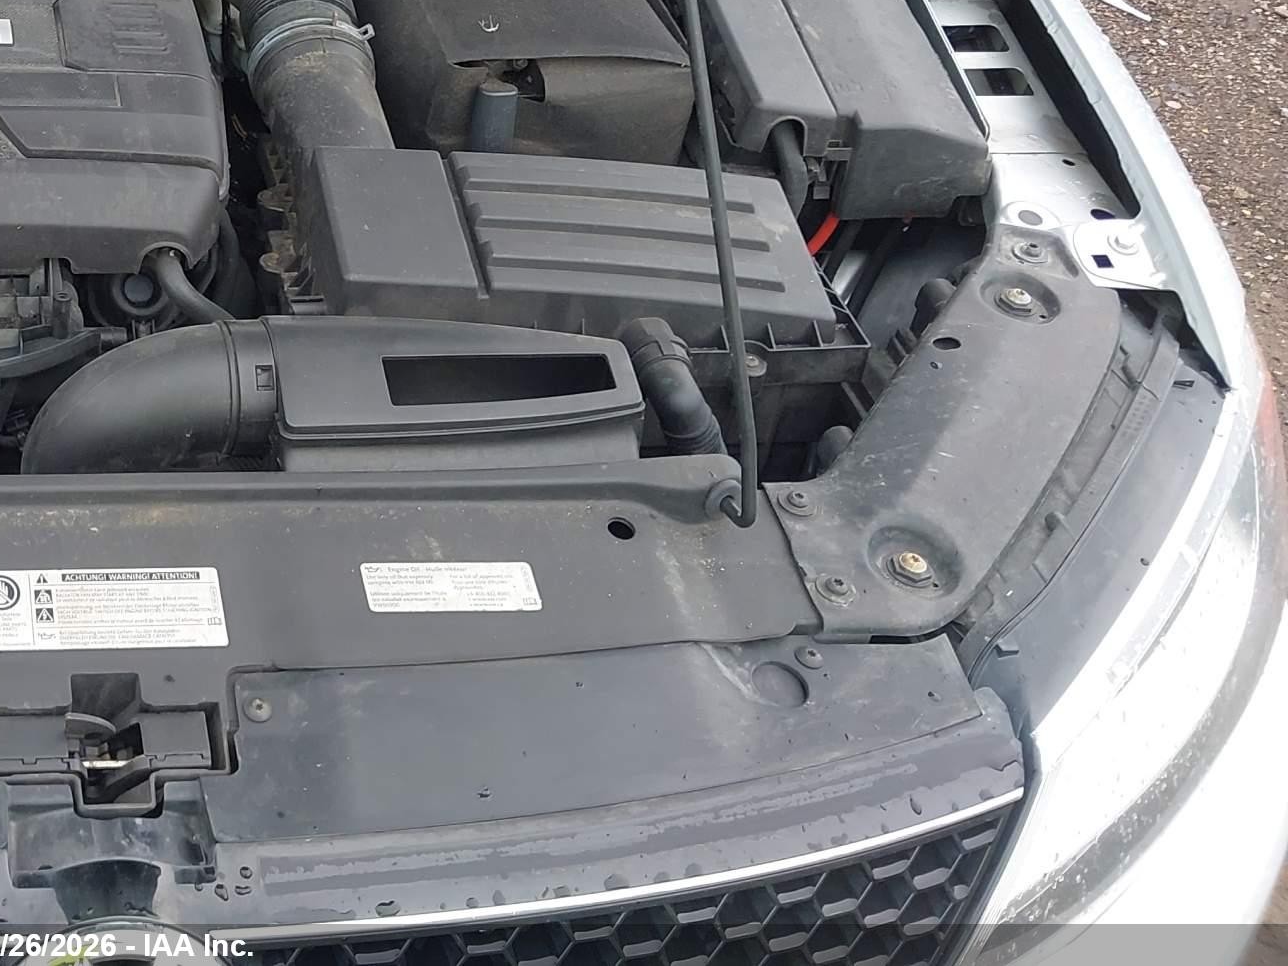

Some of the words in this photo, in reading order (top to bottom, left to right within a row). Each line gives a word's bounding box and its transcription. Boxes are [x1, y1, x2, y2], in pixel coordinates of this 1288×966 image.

[64, 573, 107, 582] ACHTUNG!
[108, 573, 150, 581] WARNING!
[151, 572, 199, 580] ATTENTION!
